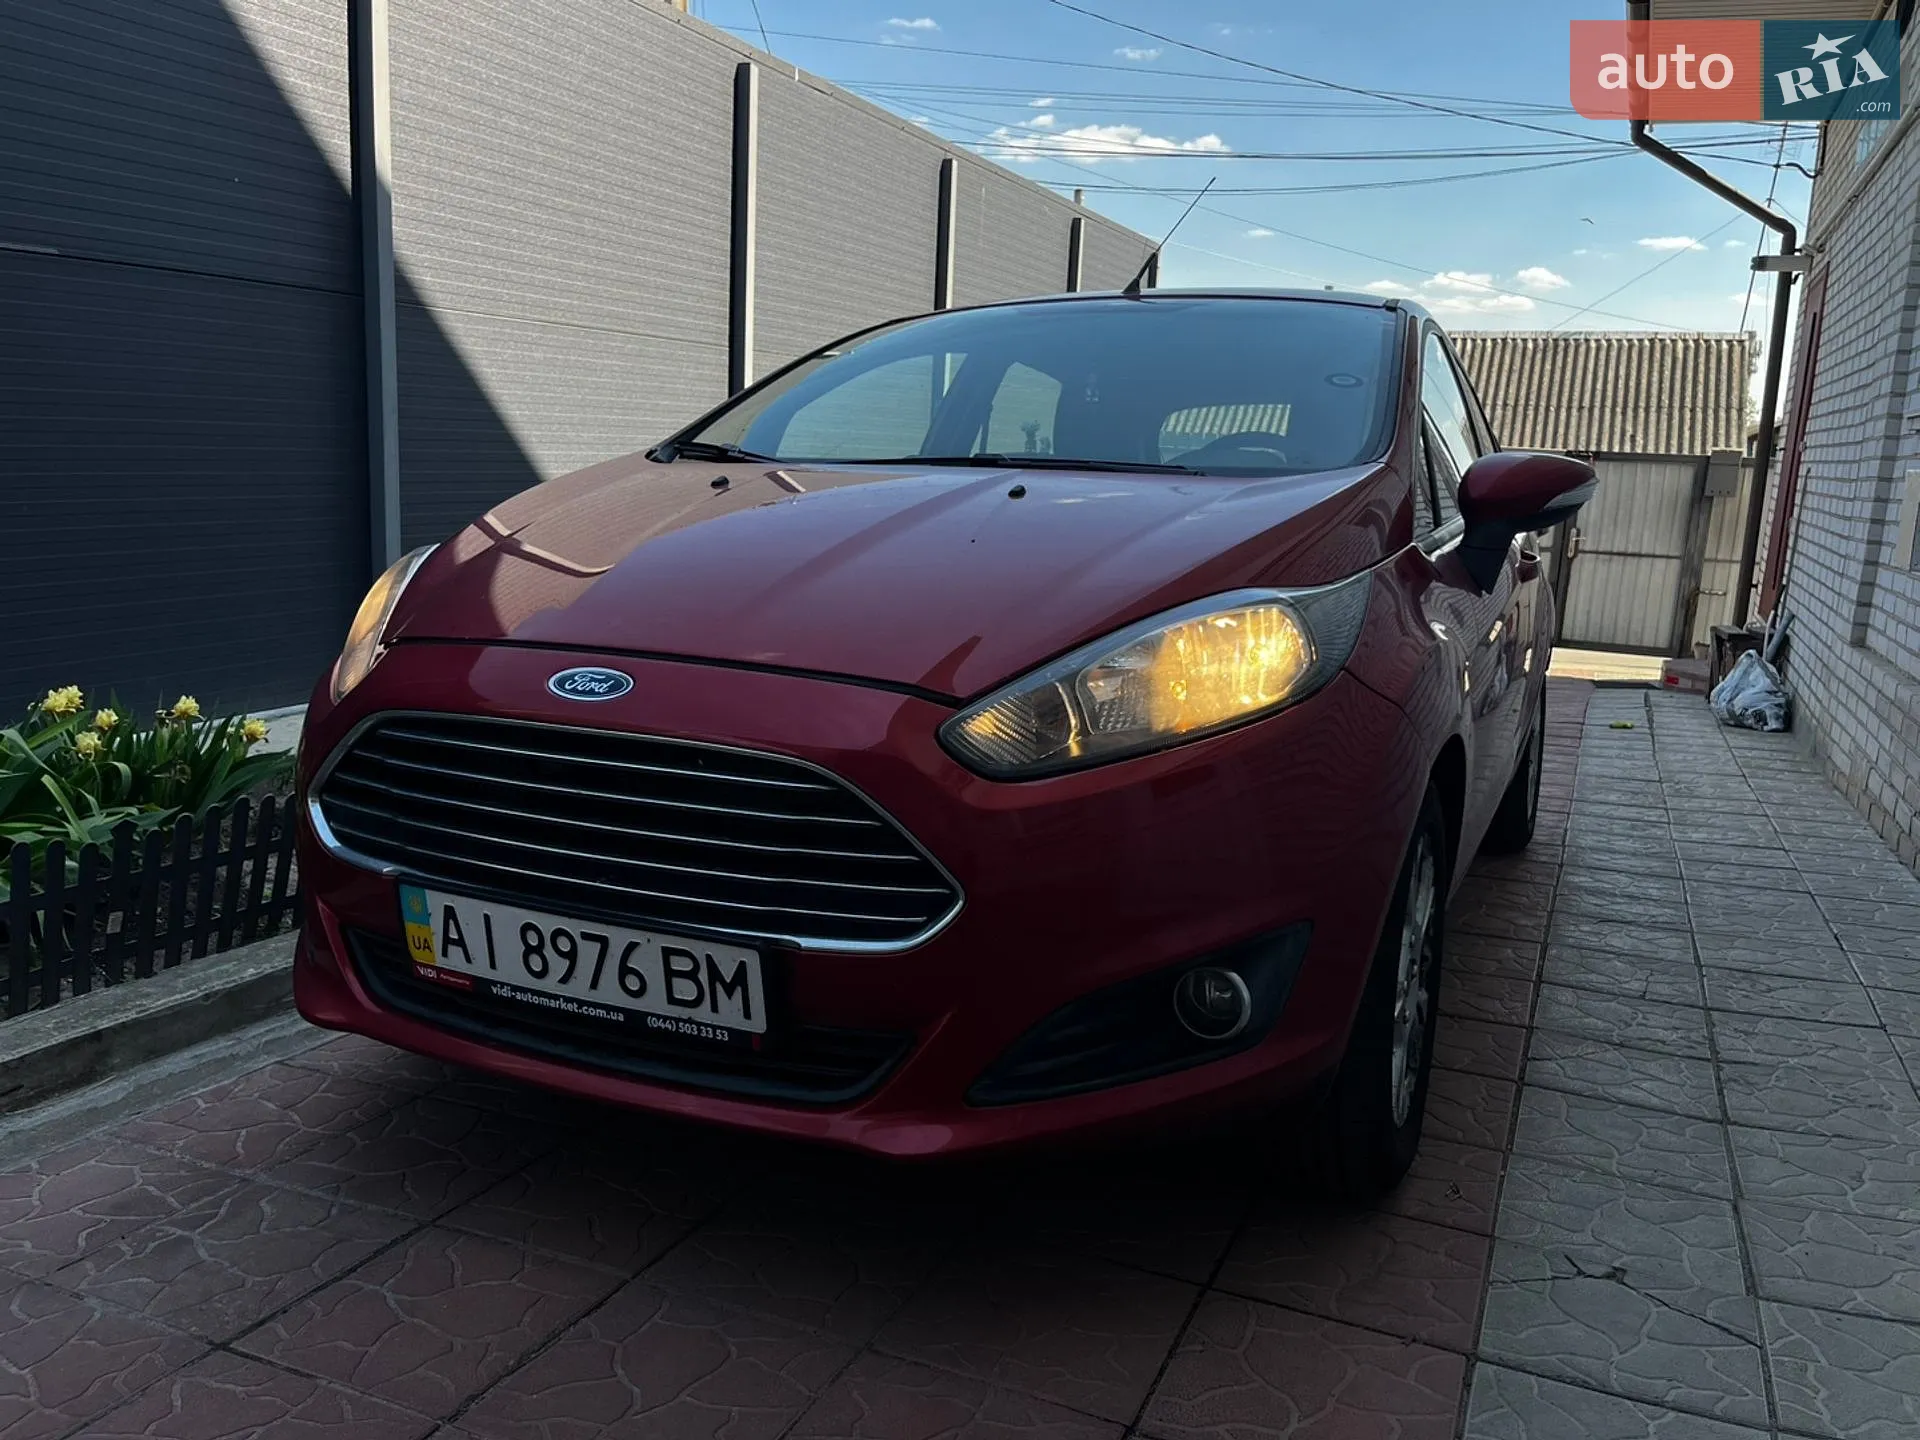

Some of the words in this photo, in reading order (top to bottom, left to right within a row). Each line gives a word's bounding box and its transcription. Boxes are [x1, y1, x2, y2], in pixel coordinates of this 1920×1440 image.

[564, 672, 614, 693] Ford
[412, 934, 433, 953] UA
[415, 965, 437, 979] VIDI
[441, 903, 497, 970] AI
[518, 920, 648, 999] 8976
[660, 944, 752, 1021] BM
[490, 983, 625, 1022] vidi-automarket.com.ua
[646, 1015, 676, 1032] (044)
[678, 1022, 698, 1036] 503
[699, 1026, 714, 1038] 33
[714, 1029, 729, 1042] 53
